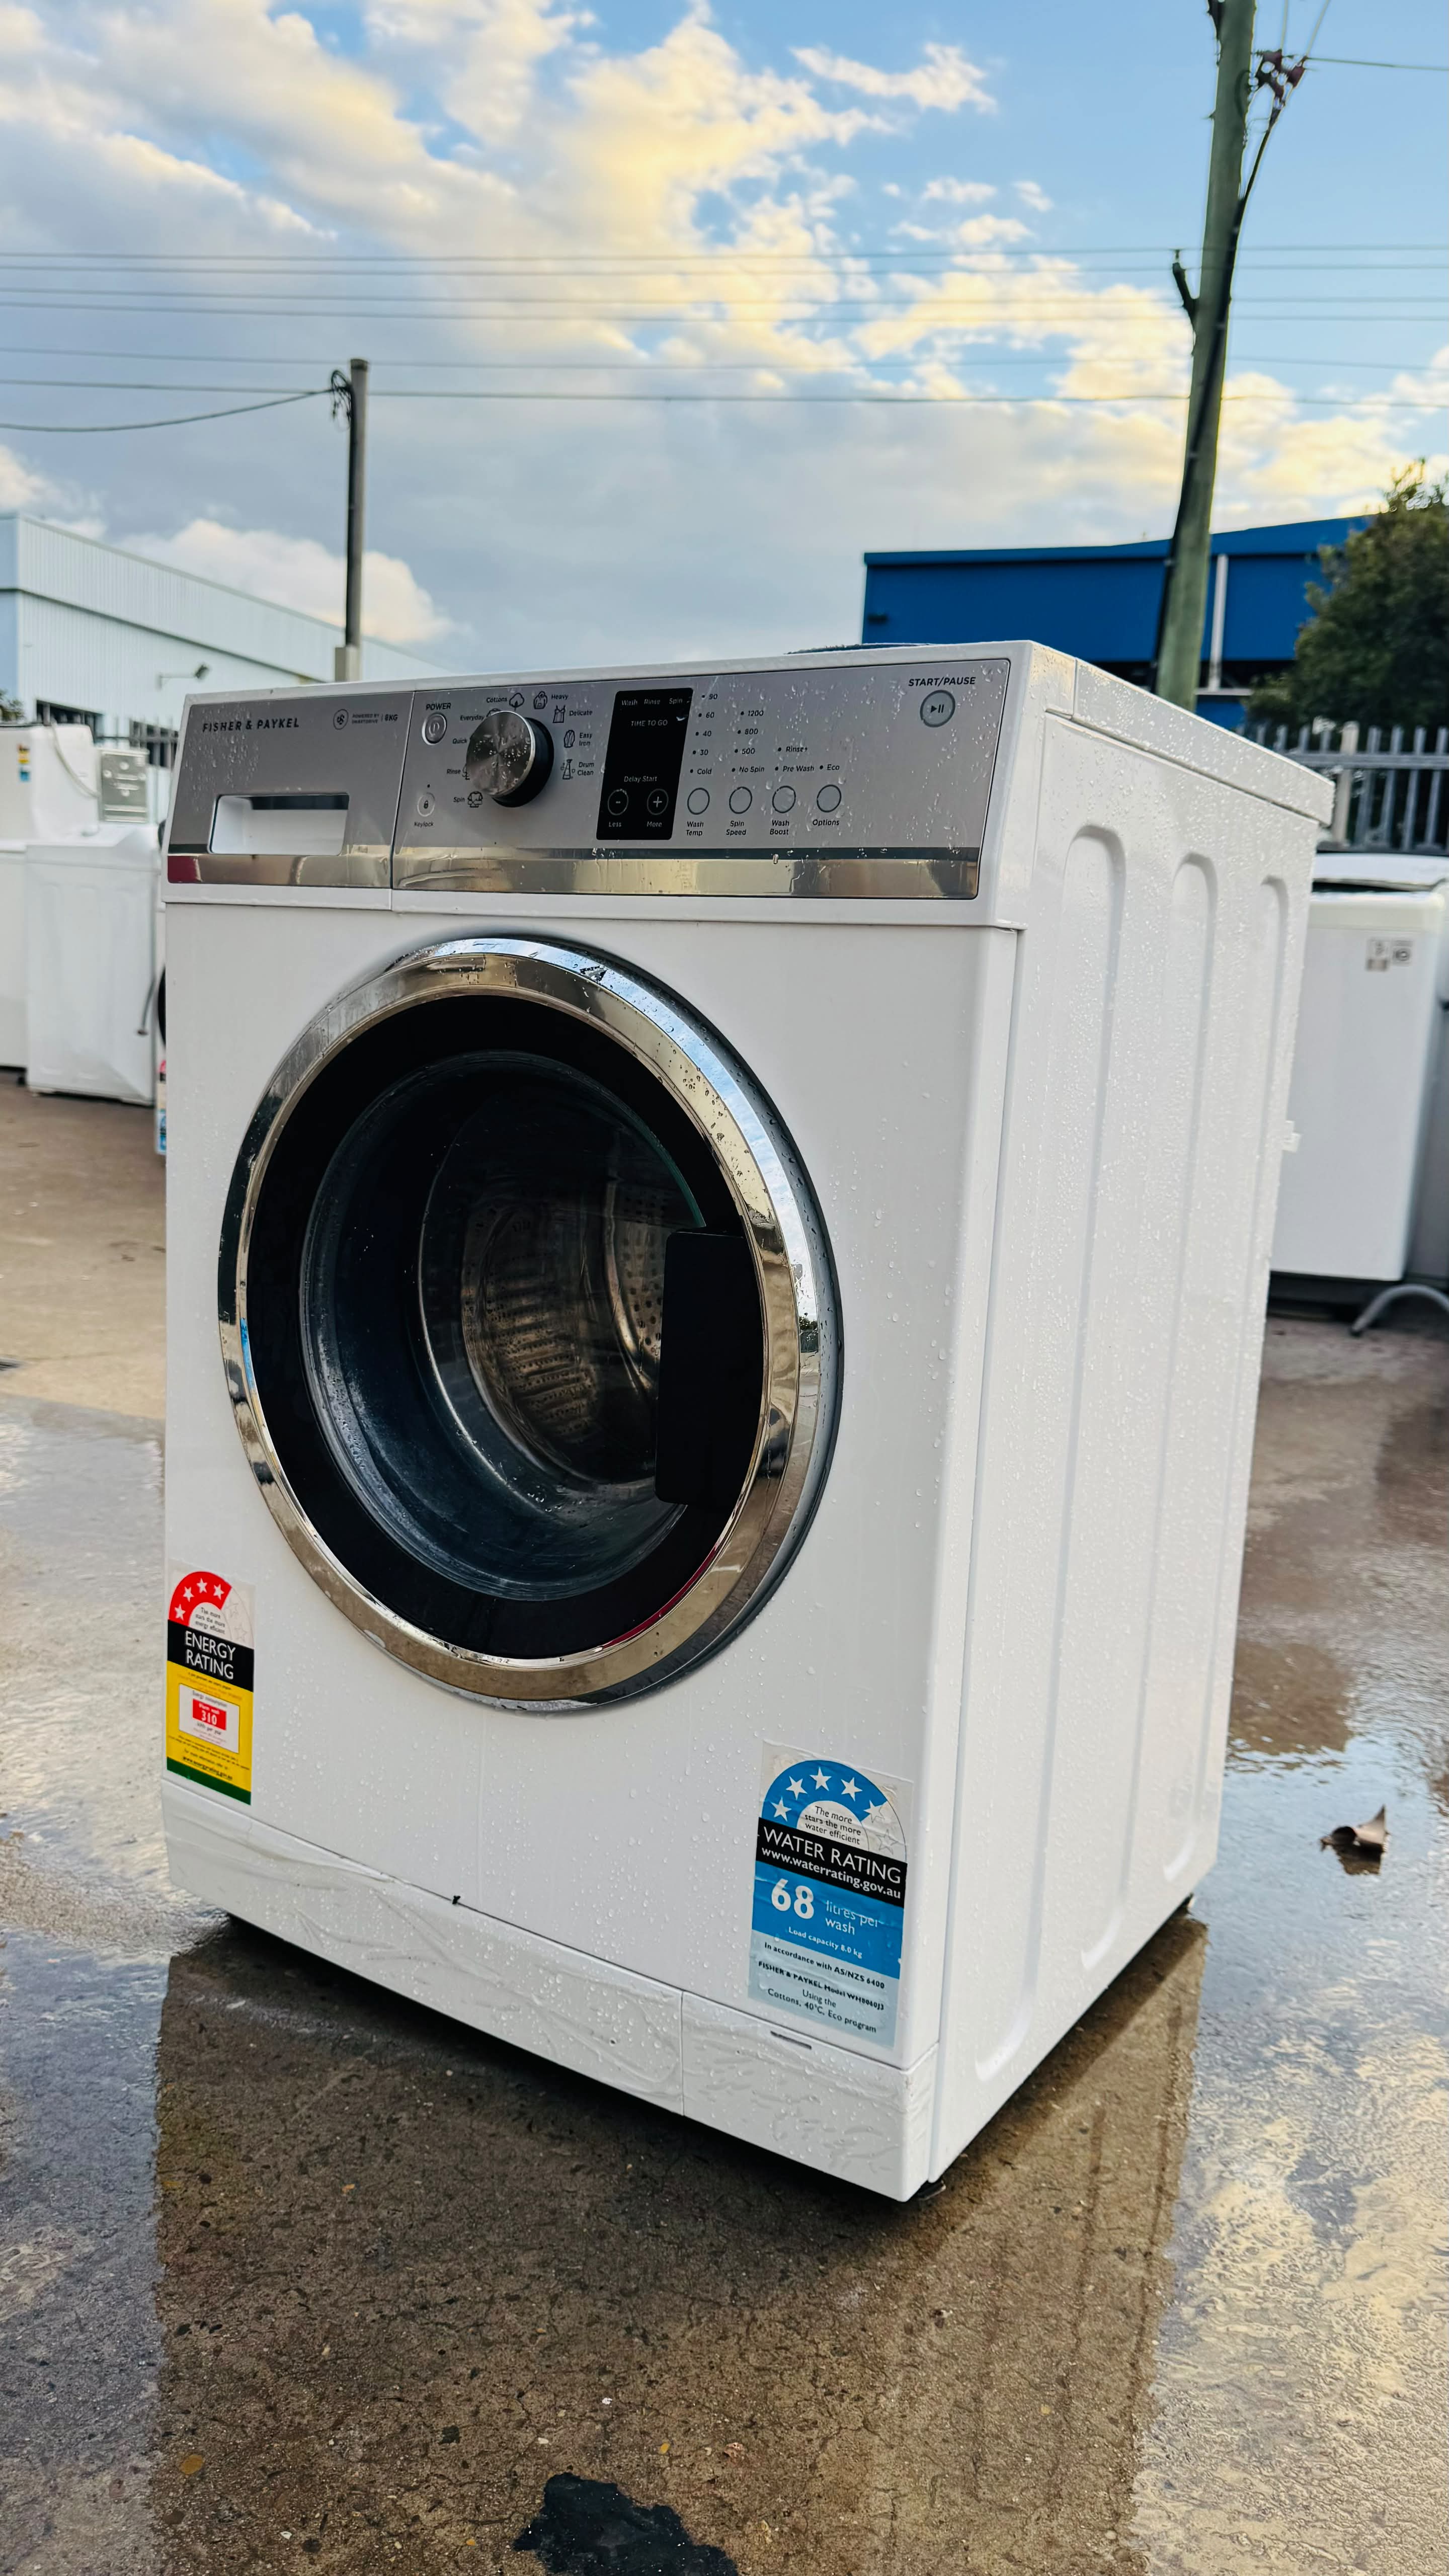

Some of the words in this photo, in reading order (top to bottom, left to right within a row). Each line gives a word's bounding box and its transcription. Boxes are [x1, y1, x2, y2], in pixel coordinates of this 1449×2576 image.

[908, 677, 976, 686] START/PAUSE
[203, 720, 242, 732] FISHER
[246, 720, 253, 730] &
[257, 717, 300, 730] PAYKEL
[185, 1631, 236, 1660] ENERGY
[186, 1649, 233, 1679] RATING
[201, 1710, 217, 1725] 310
[805, 1814, 823, 1824] stars
[826, 1819, 838, 1829] the
[840, 1824, 861, 1836] more
[815, 1805, 829, 1817] The
[831, 1813, 852, 1824] more
[805, 1822, 828, 1835] water
[829, 1828, 860, 1845] efficient
[763, 1826, 825, 1861] WATER
[831, 1847, 901, 1884] RATING
[761, 1847, 901, 1899] www.waterrating.gov.au
[771, 1878, 814, 1919] 68
[825, 1900, 856, 1920] litres
[860, 1915, 878, 1928] per
[825, 1918, 855, 1936] wash
[788, 1926, 807, 1938] Load
[808, 1934, 839, 1951] capacity
[840, 1945, 852, 1954] 8.0
[853, 1948, 863, 1959] kg
[764, 1942, 772, 1950] In
[773, 1947, 814, 1965] accordance
[816, 1961, 832, 1971] with
[834, 1966, 865, 1982] AS/NZS
[866, 1977, 885, 1989] 6400
[758, 1961, 784, 1975] FISHER
[793, 1974, 823, 1989] PAYKEL
[824, 1985, 846, 1997] Model
[802, 1989, 823, 2005] Using
[824, 1999, 837, 2008] the
[828, 2009, 842, 2022] Eco
[844, 2018, 877, 2033] program
